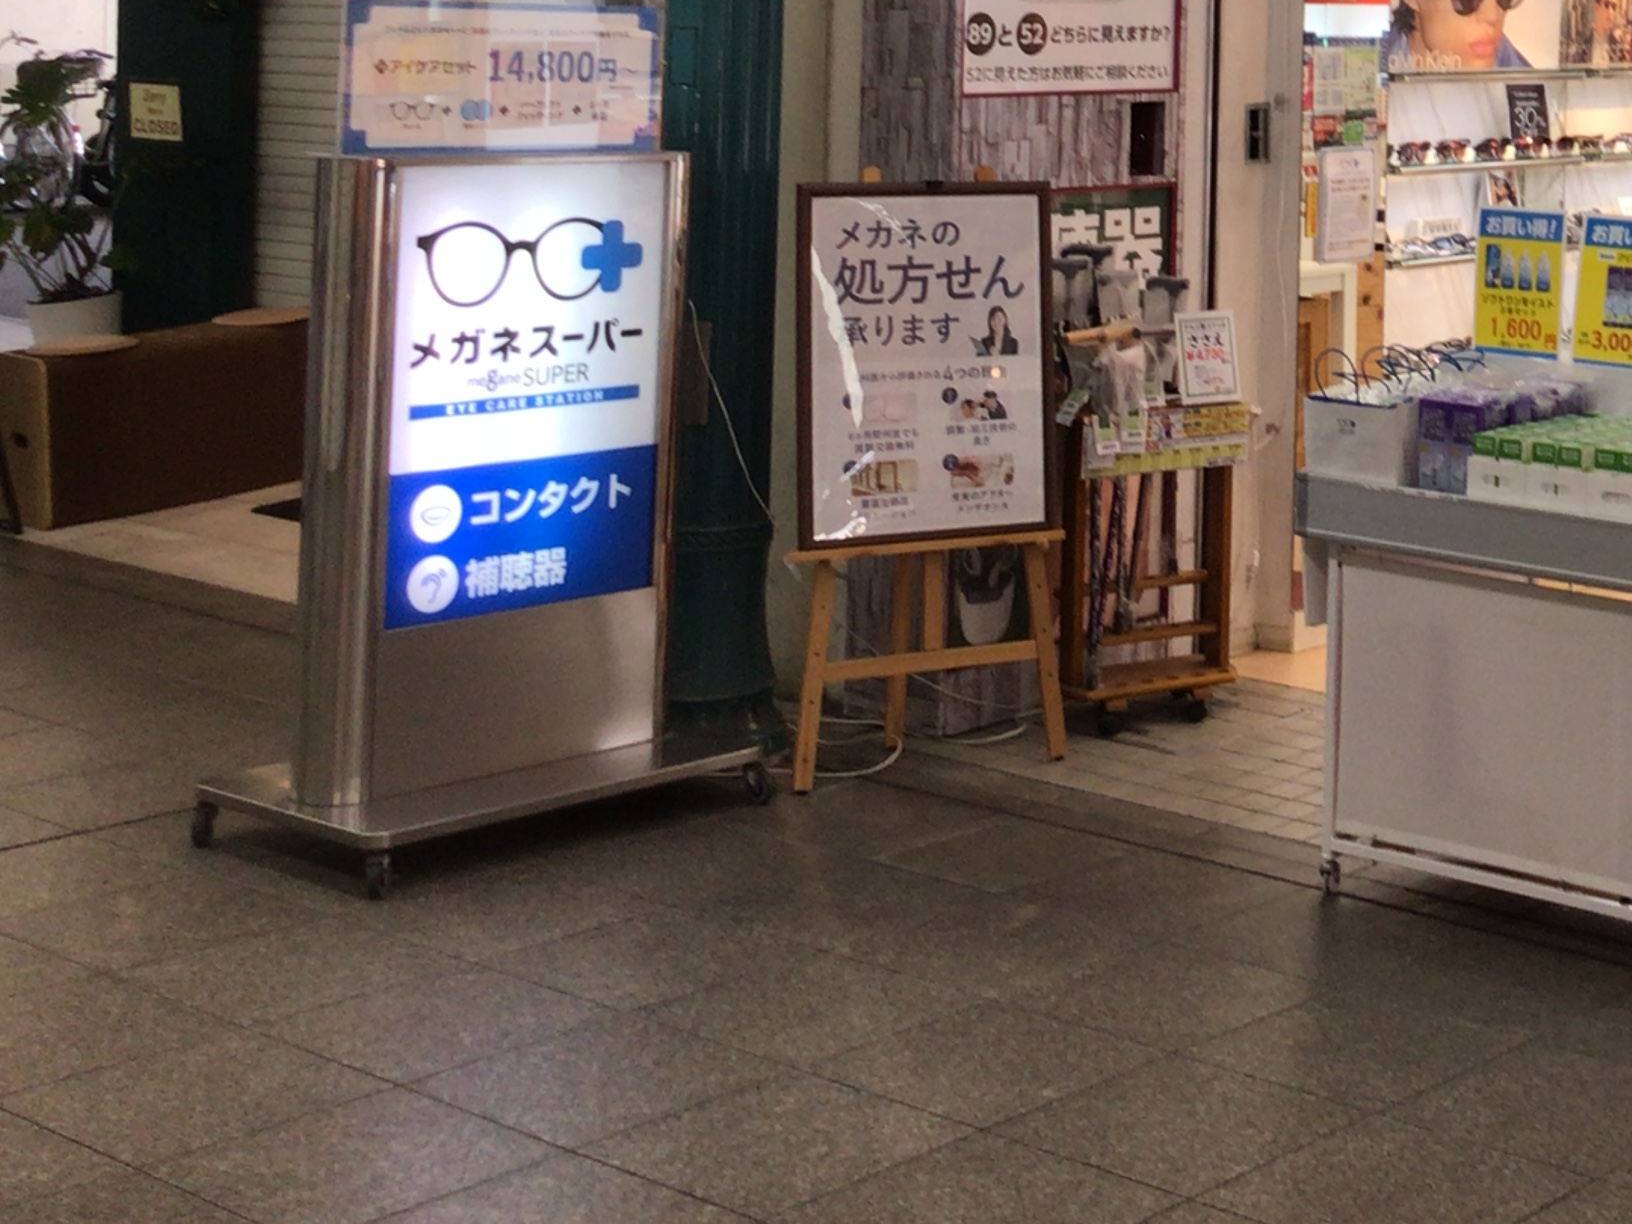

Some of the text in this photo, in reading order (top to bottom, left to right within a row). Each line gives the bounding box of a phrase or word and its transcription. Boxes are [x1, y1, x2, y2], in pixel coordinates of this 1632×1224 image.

[834, 254, 1025, 305] 処方せん
[410, 318, 643, 369] メガネスーパー
[843, 312, 961, 347] 承ります
[445, 389, 605, 416] EYE CARE STATION
[470, 474, 632, 526] コンタクト
[465, 546, 568, 599] 補聴器
